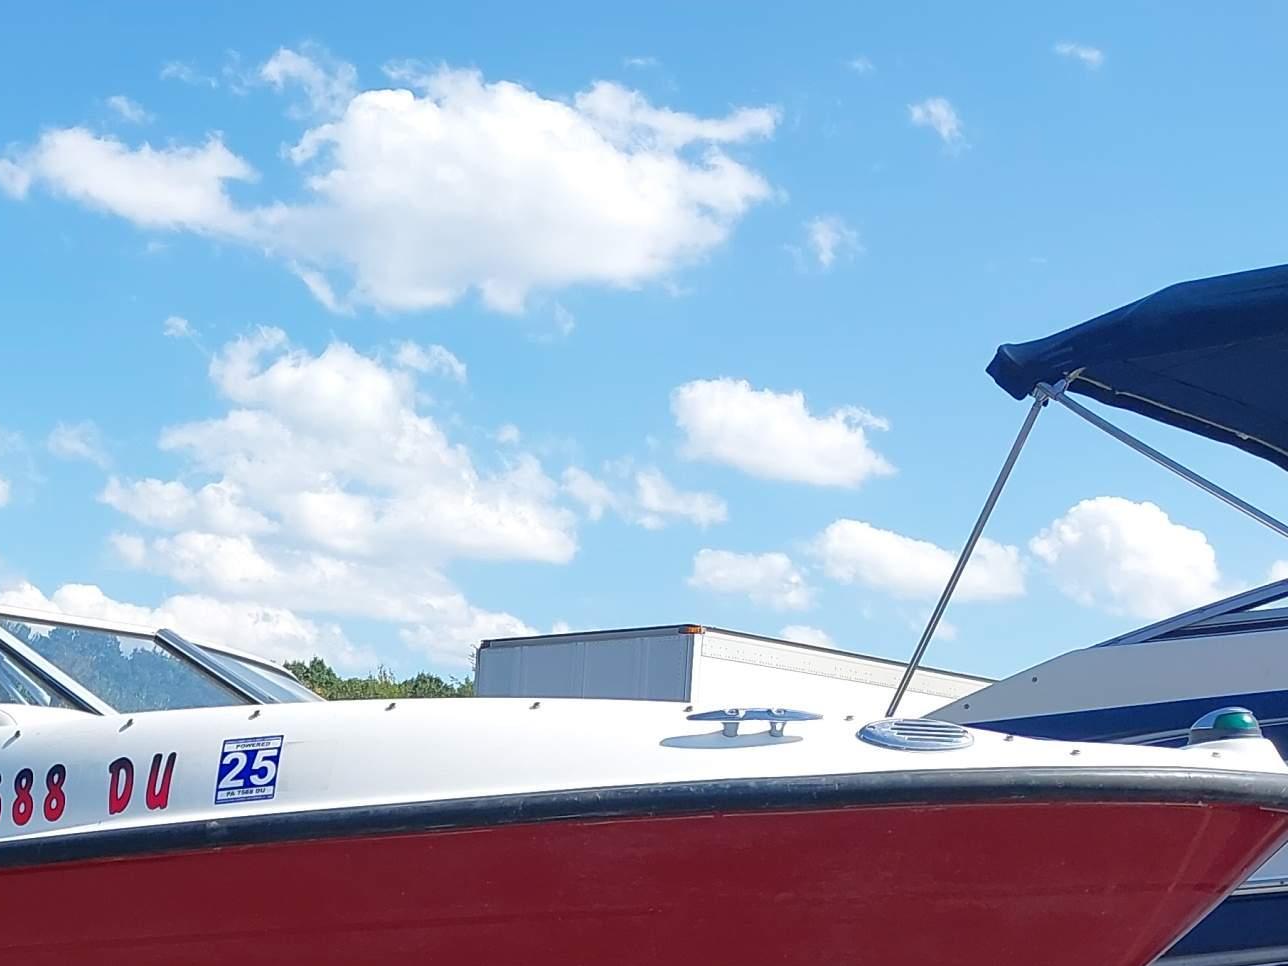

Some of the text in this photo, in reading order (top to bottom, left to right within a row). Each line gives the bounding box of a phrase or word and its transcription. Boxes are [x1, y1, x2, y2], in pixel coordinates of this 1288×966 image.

[235, 742, 271, 750] POWERED
[108, 751, 177, 815] DU
[218, 748, 278, 789] 25
